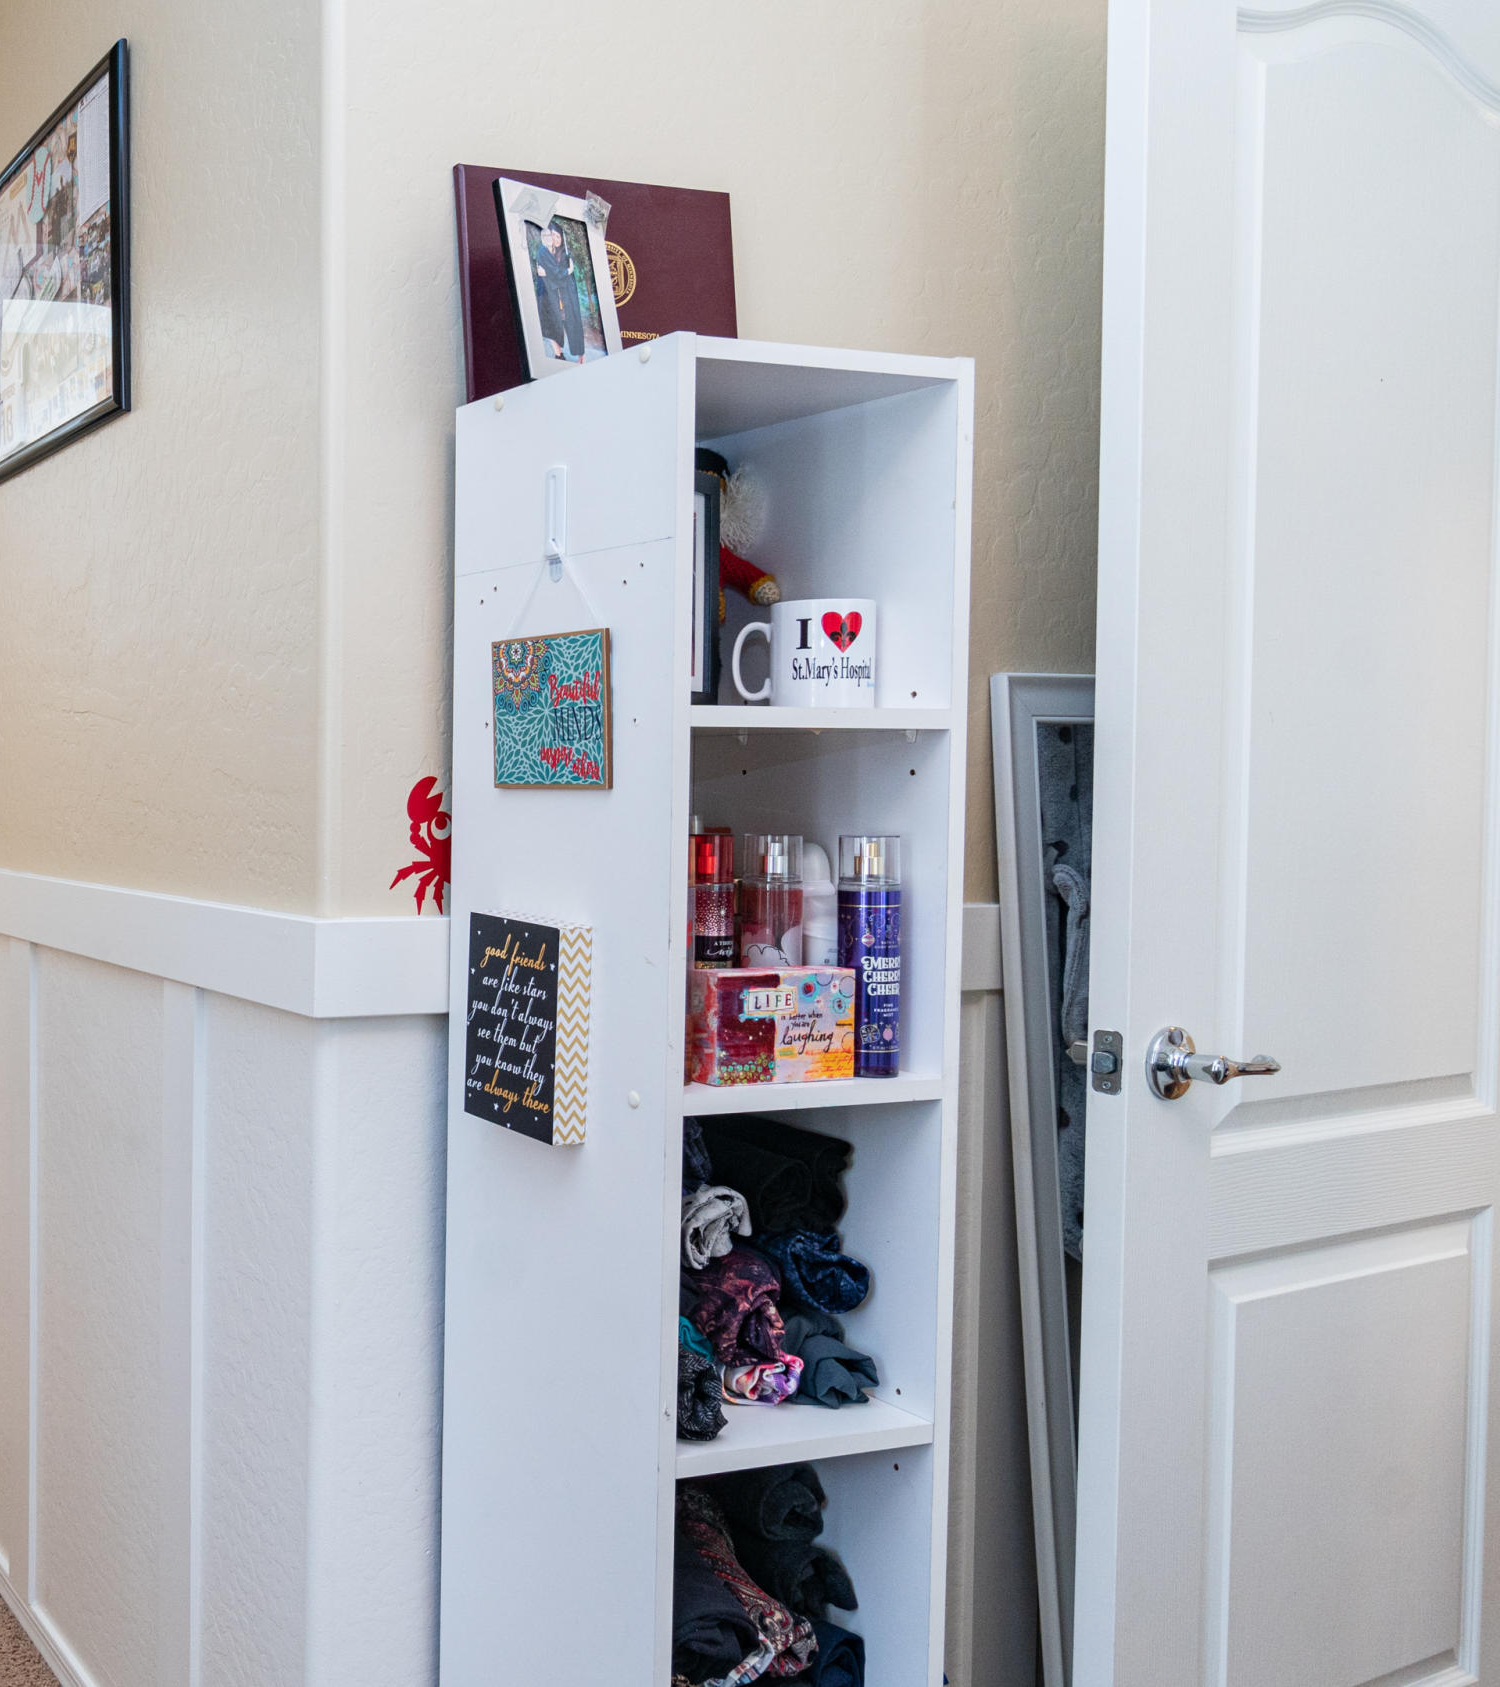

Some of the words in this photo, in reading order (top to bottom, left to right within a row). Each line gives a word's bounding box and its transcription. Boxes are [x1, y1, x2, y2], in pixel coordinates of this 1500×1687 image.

[796, 618, 812, 650] I
[548, 671, 600, 707] Beautiful
[480, 933, 511, 968] good
[508, 941, 547, 976] friends
[861, 956, 900, 970] MERR
[482, 976, 499, 988] are
[500, 964, 520, 994] like
[523, 976, 548, 1000] stars
[863, 971, 900, 983] CHERR
[468, 1000, 488, 1021] you
[491, 995, 519, 1020] don't
[518, 998, 554, 1041] always
[754, 993, 792, 1010] LIFE
[477, 1027, 491, 1039] see
[493, 1018, 517, 1048] them
[519, 1024, 541, 1054] but
[471, 1054, 492, 1075] you
[495, 1046, 521, 1075] know
[523, 1053, 545, 1096] they
[467, 1078, 483, 1090] are
[484, 1069, 519, 1112] always
[522, 1081, 550, 1113] there
